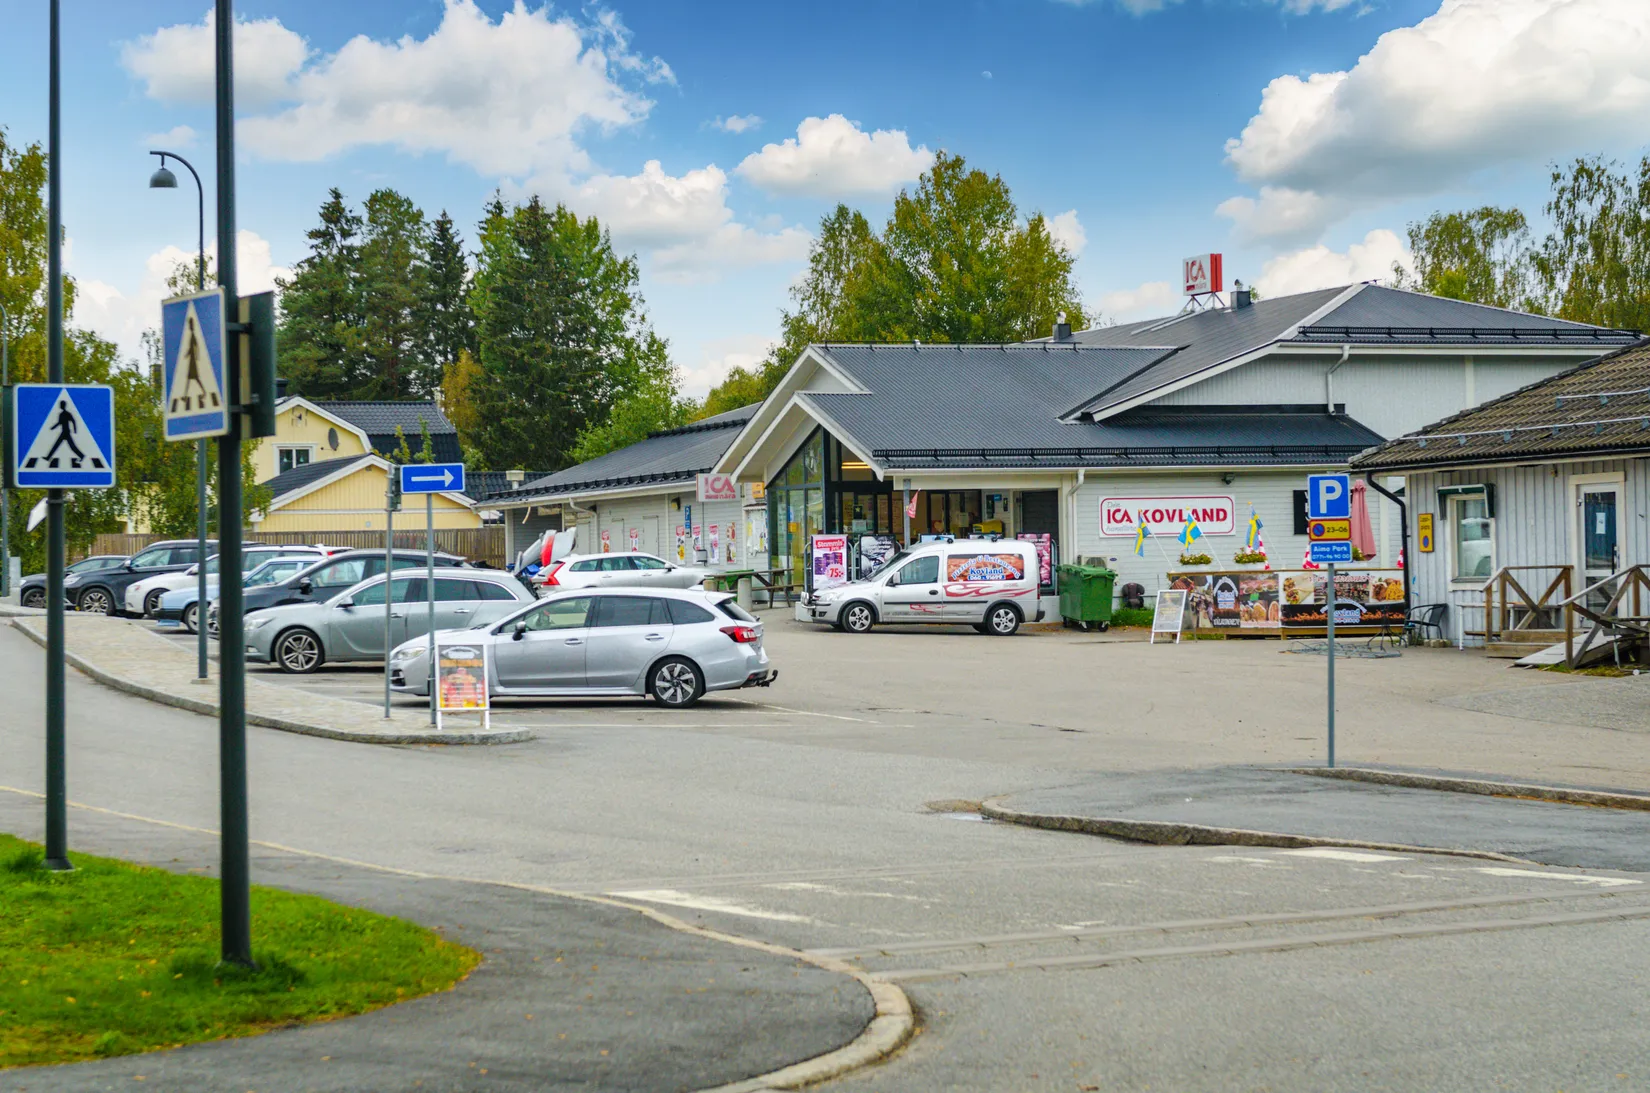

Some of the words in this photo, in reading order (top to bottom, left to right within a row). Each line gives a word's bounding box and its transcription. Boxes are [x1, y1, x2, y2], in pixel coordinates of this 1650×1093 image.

[1185, 260, 1206, 284] ICA
[704, 476, 735, 493] ICA
[1319, 479, 1343, 514] P
[1107, 508, 1133, 524] ICA
[1138, 508, 1228, 524] KOVLAND
[951, 557, 977, 580] Pizzeria
[984, 555, 1021, 580] Restaurang
[970, 567, 1004, 575] Kovland
